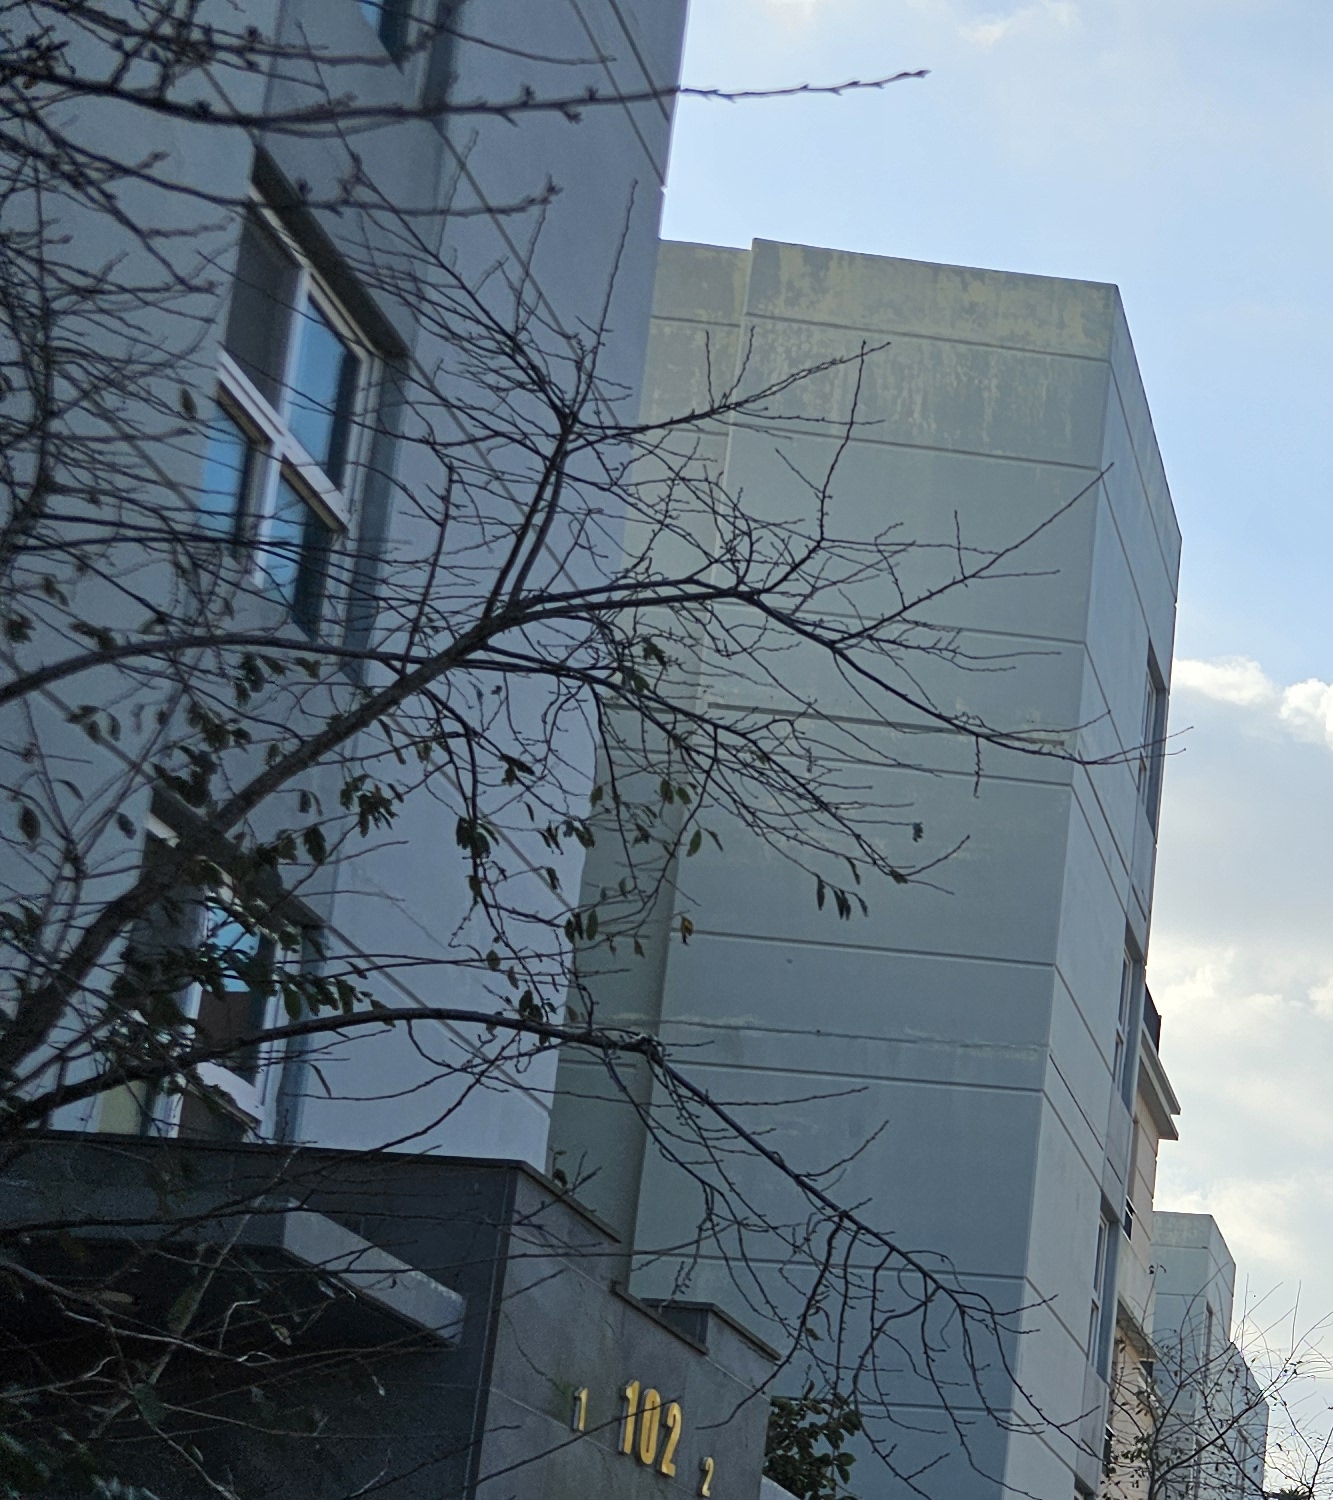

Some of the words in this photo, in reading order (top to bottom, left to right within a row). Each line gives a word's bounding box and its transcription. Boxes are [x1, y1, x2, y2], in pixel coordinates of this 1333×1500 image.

[574, 1386, 588, 1431] 1
[619, 1380, 682, 1477] 102
[702, 1456, 714, 1497] 2
